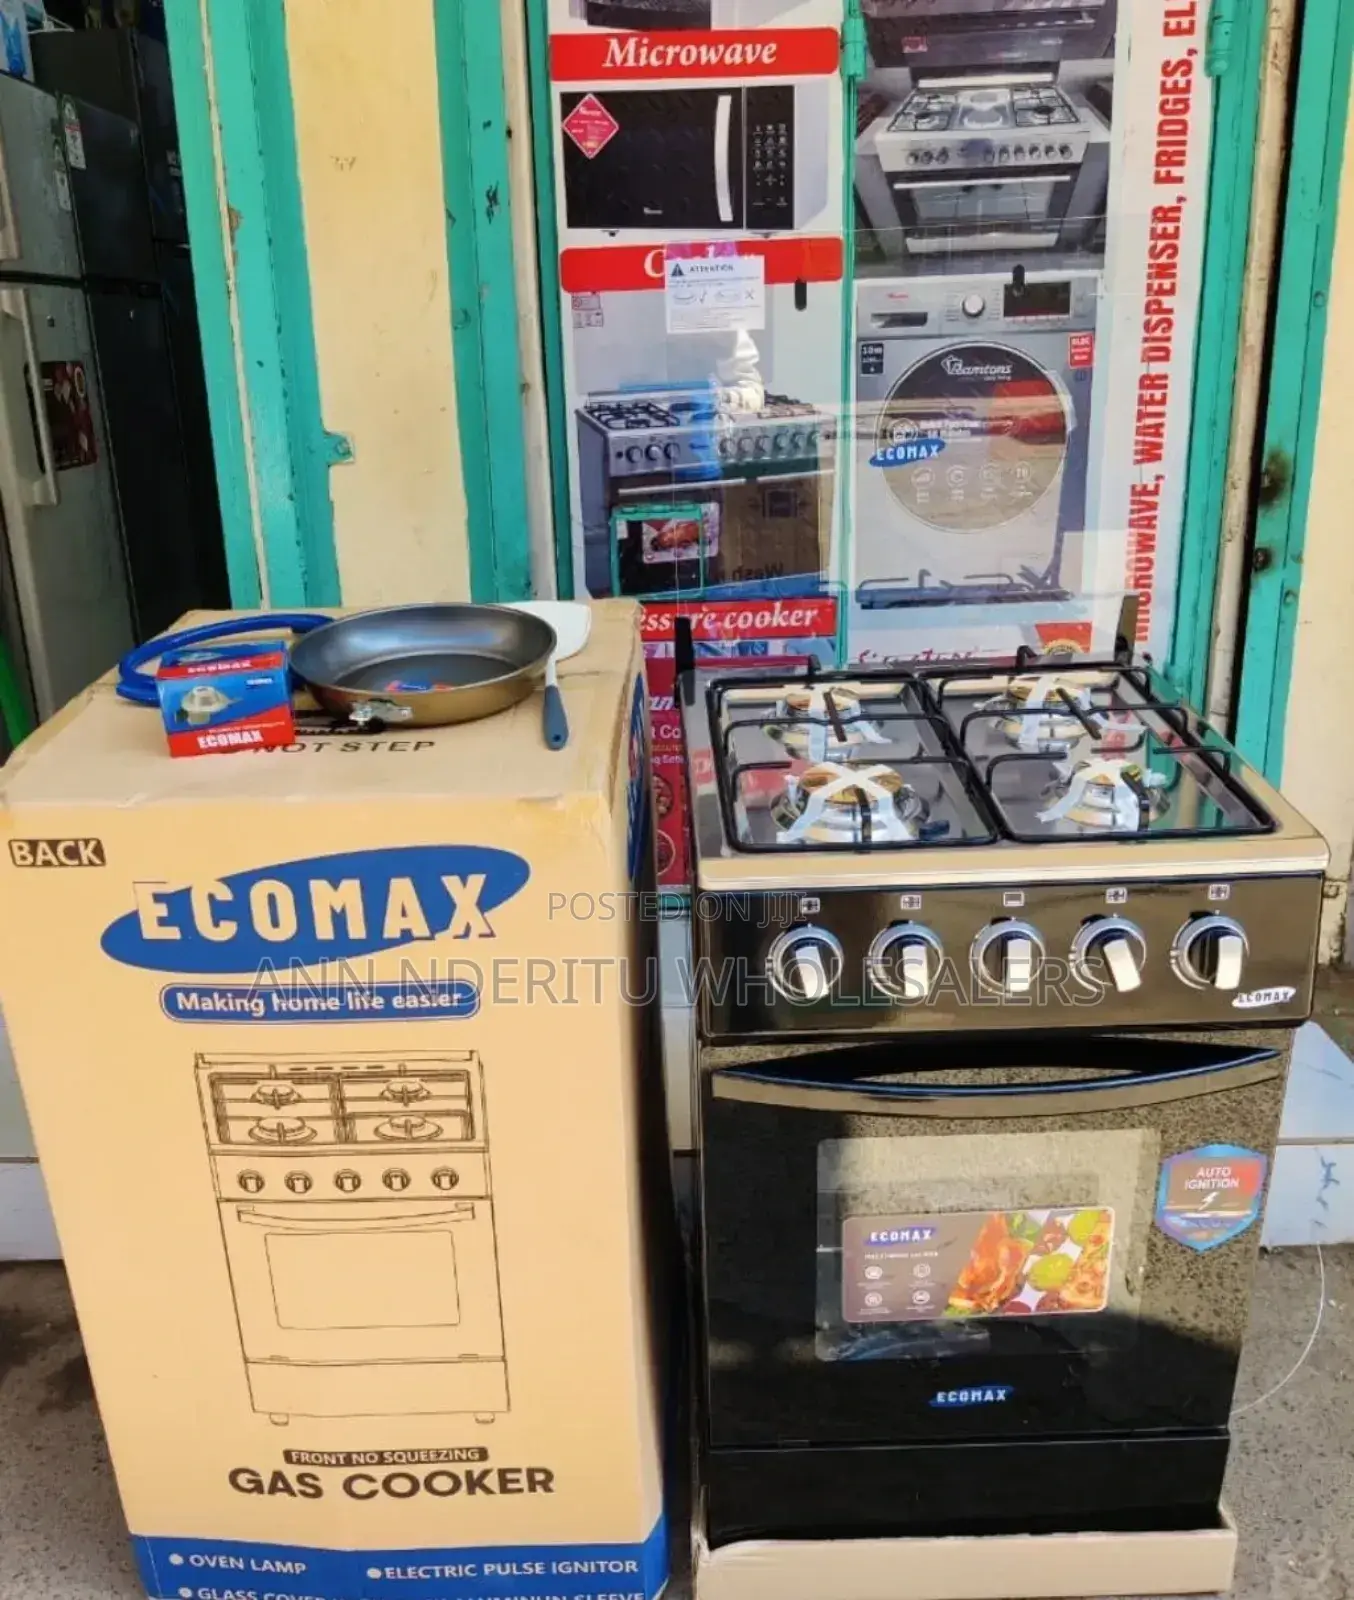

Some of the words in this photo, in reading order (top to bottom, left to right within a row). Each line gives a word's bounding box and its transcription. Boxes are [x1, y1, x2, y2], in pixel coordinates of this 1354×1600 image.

[1163, 0, 1196, 37] EL
[602, 36, 777, 67] Microwave
[1153, 48, 1198, 185] FRIDGES,
[689, 263, 734, 273] ATTENTION
[1141, 195, 1187, 363] DISPENSER,
[1133, 373, 1168, 465] WATER
[877, 444, 939, 461] ECOMAX
[725, 602, 819, 630] cooker
[198, 729, 264, 748] ECOMAX
[340, 741, 435, 753] STEP
[13, 840, 103, 867] BACK
[133, 874, 496, 941] ECOMAX
[177, 992, 265, 1017] Making
[272, 992, 341, 1012] home
[347, 991, 385, 1010] life
[392, 990, 462, 1009] easier
[1237, 991, 1290, 1004] ECOMAX
[1196, 1166, 1232, 1178] AUTO
[1185, 1178, 1240, 1191] IGNITION
[870, 1229, 932, 1243] ECOMAX
[936, 1389, 1007, 1404] ECOMAX
[291, 1450, 347, 1466] FRONT
[352, 1451, 379, 1465] NO
[383, 1447, 480, 1464] SQUEEZING
[228, 1467, 324, 1499] GAS
[342, 1467, 555, 1500] COOKER
[189, 1554, 245, 1570] OVEN
[250, 1560, 307, 1575] LAMP
[384, 1563, 477, 1580] ELECTRIC
[483, 1562, 546, 1577] PULSE
[552, 1559, 639, 1574] IGNITOR
